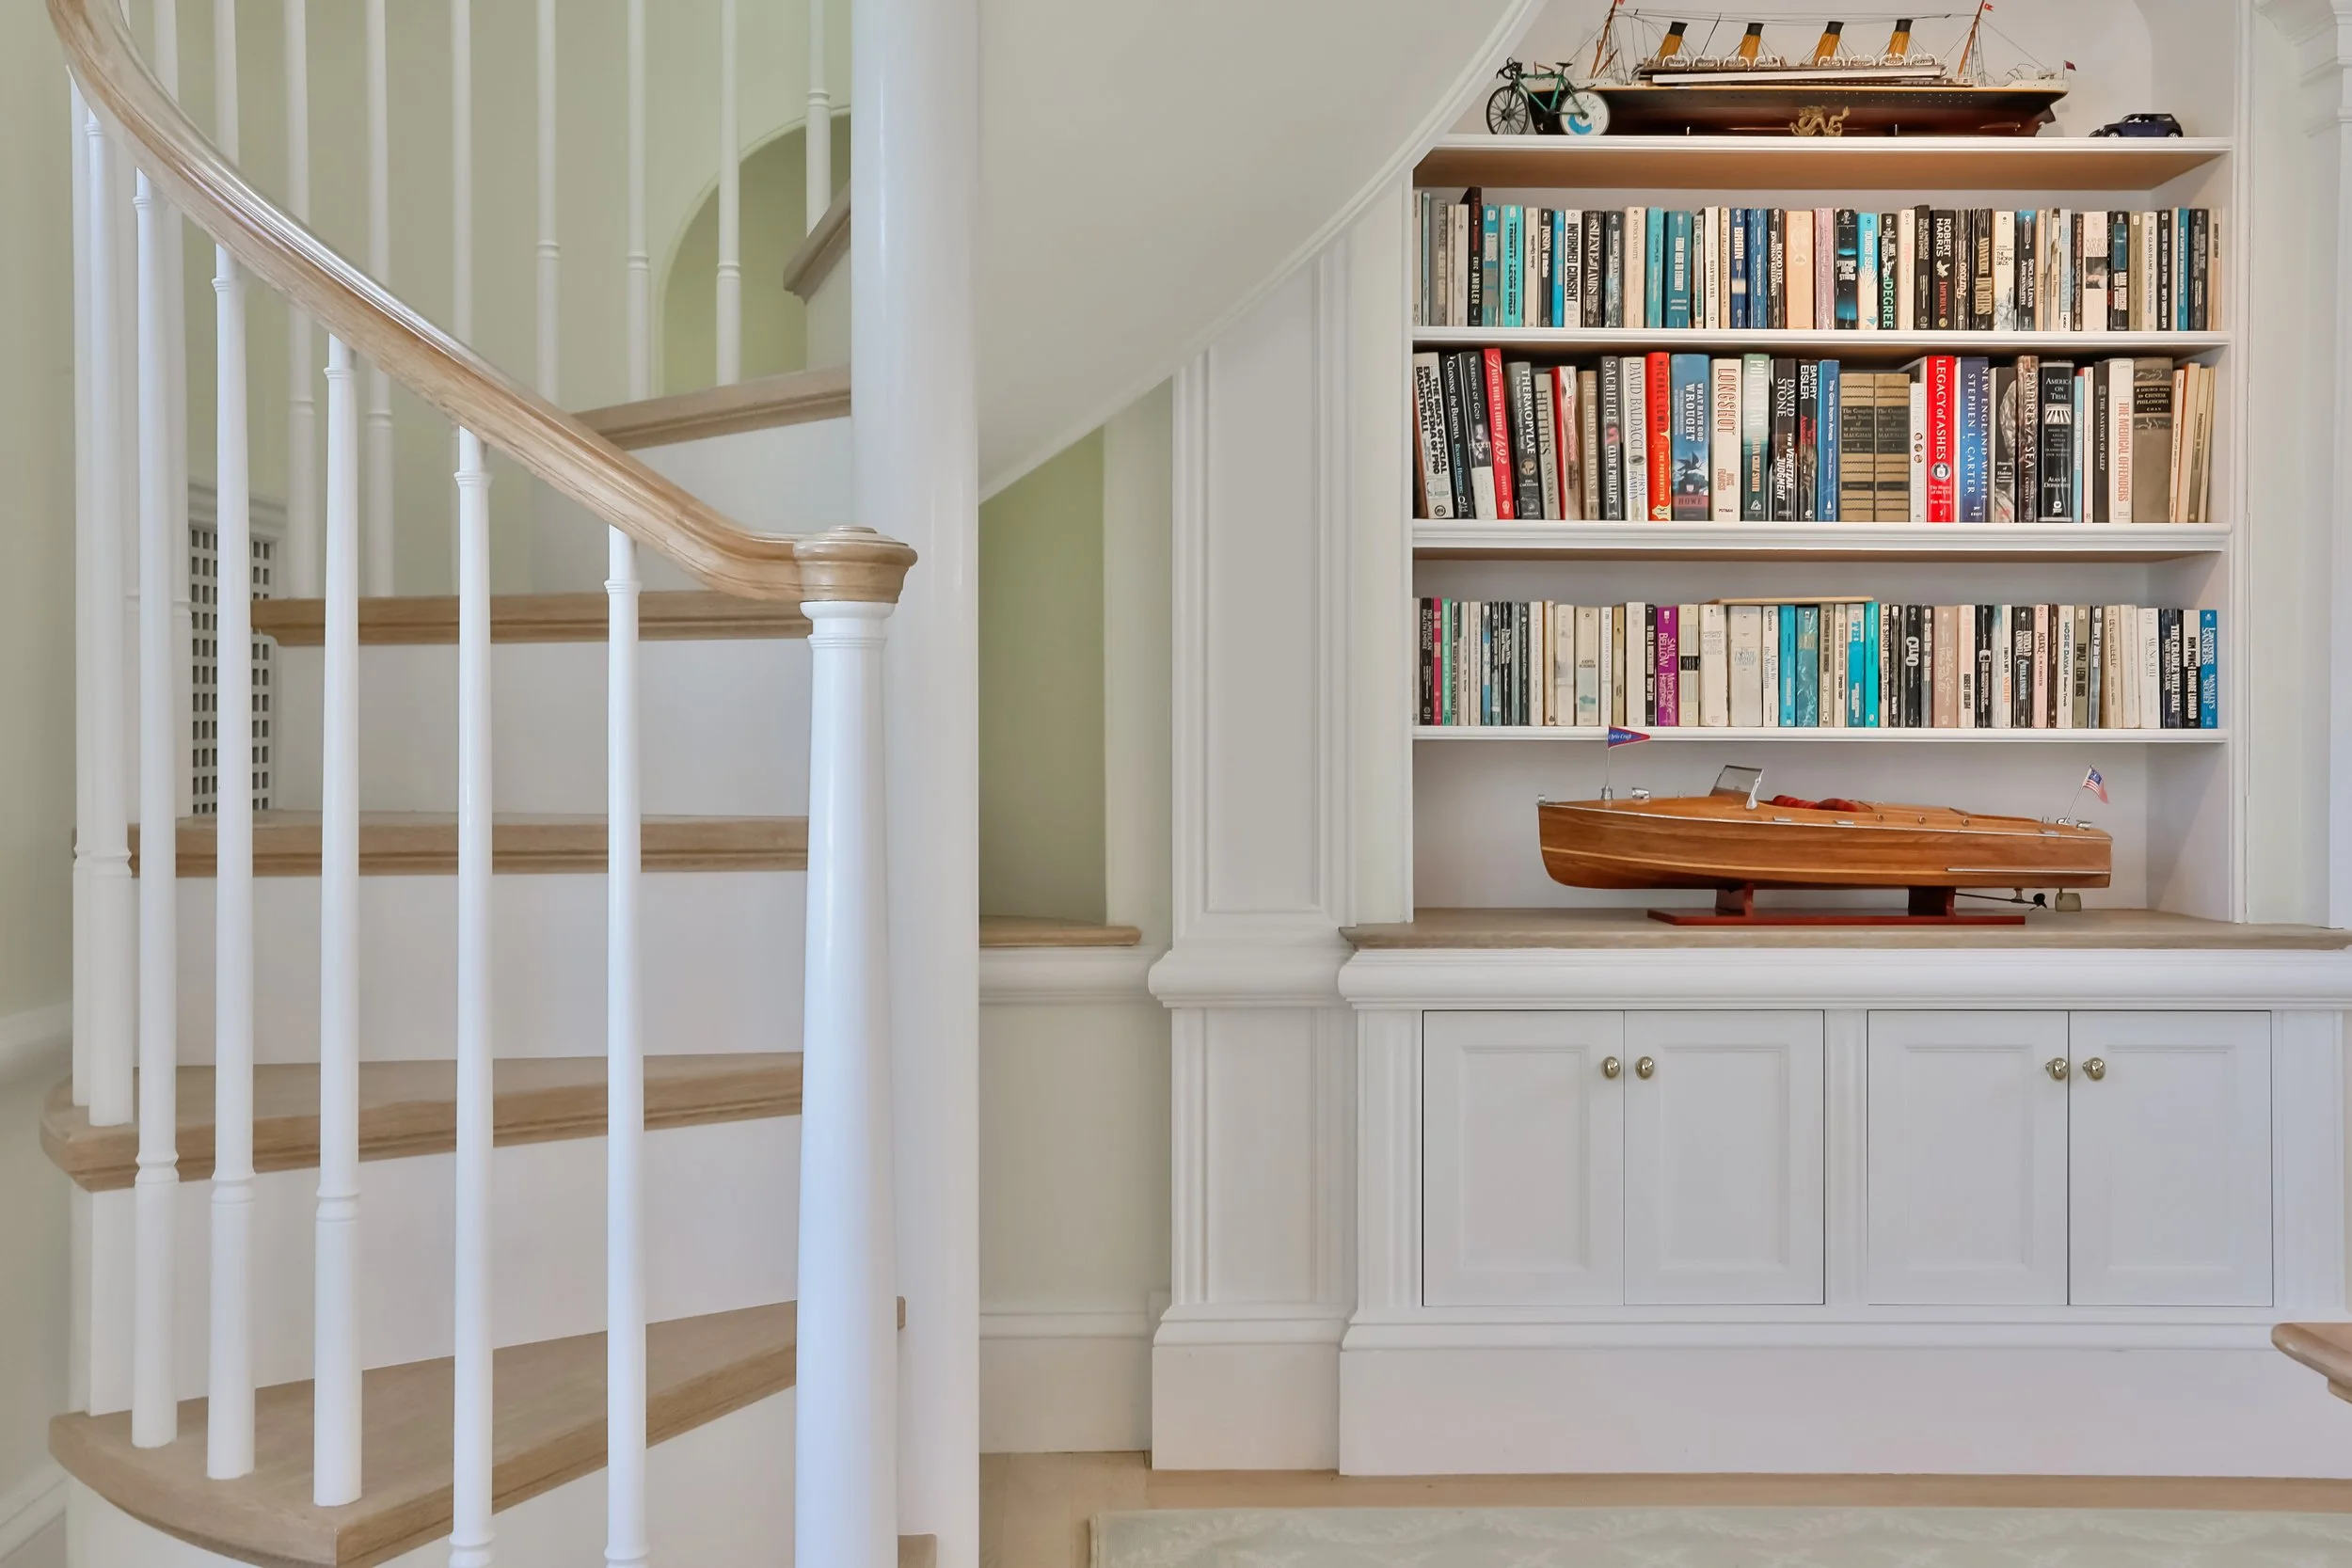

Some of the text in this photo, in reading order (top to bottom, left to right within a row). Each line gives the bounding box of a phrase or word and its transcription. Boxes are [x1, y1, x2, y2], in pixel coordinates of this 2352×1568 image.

[1508, 222, 1518, 261] TRINITY
[1734, 227, 1744, 260] BRAIN
[1865, 230, 1873, 254] TOURIST
[1566, 223, 1579, 303] INFORMED CONSENT
[1976, 237, 1993, 315] SHIBUMI TREVANIAN
[1471, 273, 1480, 305] AMBLER
[1508, 291, 1518, 316] URIS
[1883, 282, 1894, 328] DEGREE
[1939, 282, 1948, 315] IMPERIUM
[1469, 356, 1477, 390] WARRIORS
[1801, 365, 1809, 400] EISLER
[1416, 366, 1428, 434] BASKETBALL
[1433, 398, 1442, 427] NBA'S
[1447, 361, 1455, 393] CLONING
[1451, 407, 1459, 439] BUDDHA
[1472, 391, 1478, 400] OF
[1520, 368, 1535, 454] THERMOPYLAE
[1629, 362, 1643, 451] DAVID BALDACCI
[1657, 360, 1665, 433] MICHAEL LEWIS
[1686, 383, 1695, 442] WROUGHT
[1718, 369, 1737, 436] LONGSHOT
[1777, 377, 1787, 418] STONE
[1787, 378, 1795, 417] DAVID
[1935, 359, 1947, 460] LEGACY of ASHES
[1423, 366, 1440, 475] ENCYCLOPEDIA OF PRO
[1535, 390, 1550, 455] HITTITES
[1587, 405, 1597, 431] RIGHTS
[1605, 361, 1618, 504] SACRIFICE CLYDE PHILLIPS
[1967, 373, 1976, 494] STEPHEN L. CARTER
[2025, 372, 2036, 468] EMPIRES SEA
[1437, 429, 1447, 474] OFFICIAL
[1495, 431, 1507, 464] 1492
[1588, 435, 1597, 454] FROM
[2118, 402, 2130, 501] THE MEDICAL OFFENDERS
[1629, 470, 1638, 500] FAMILY
[1752, 472, 1760, 492] SMITH
[1776, 457, 1786, 500] JUDGMENT
[1786, 448, 1794, 489] VENETIAN
[1677, 497, 1703, 505] HOWE
[1659, 632, 1669, 667] BELLOW
[1667, 638, 1676, 658] SAUL
[1905, 636, 1919, 667] CUJO
[2075, 643, 2087, 697] TOPAZ LEON URIS
[2170, 625, 2180, 713] THE CRADLE WILL FALL
[2187, 637, 2197, 719] RUM ELMORE LEONARD
[1659, 673, 1668, 708] Heartbreak
[1666, 689, 1675, 701] Die
